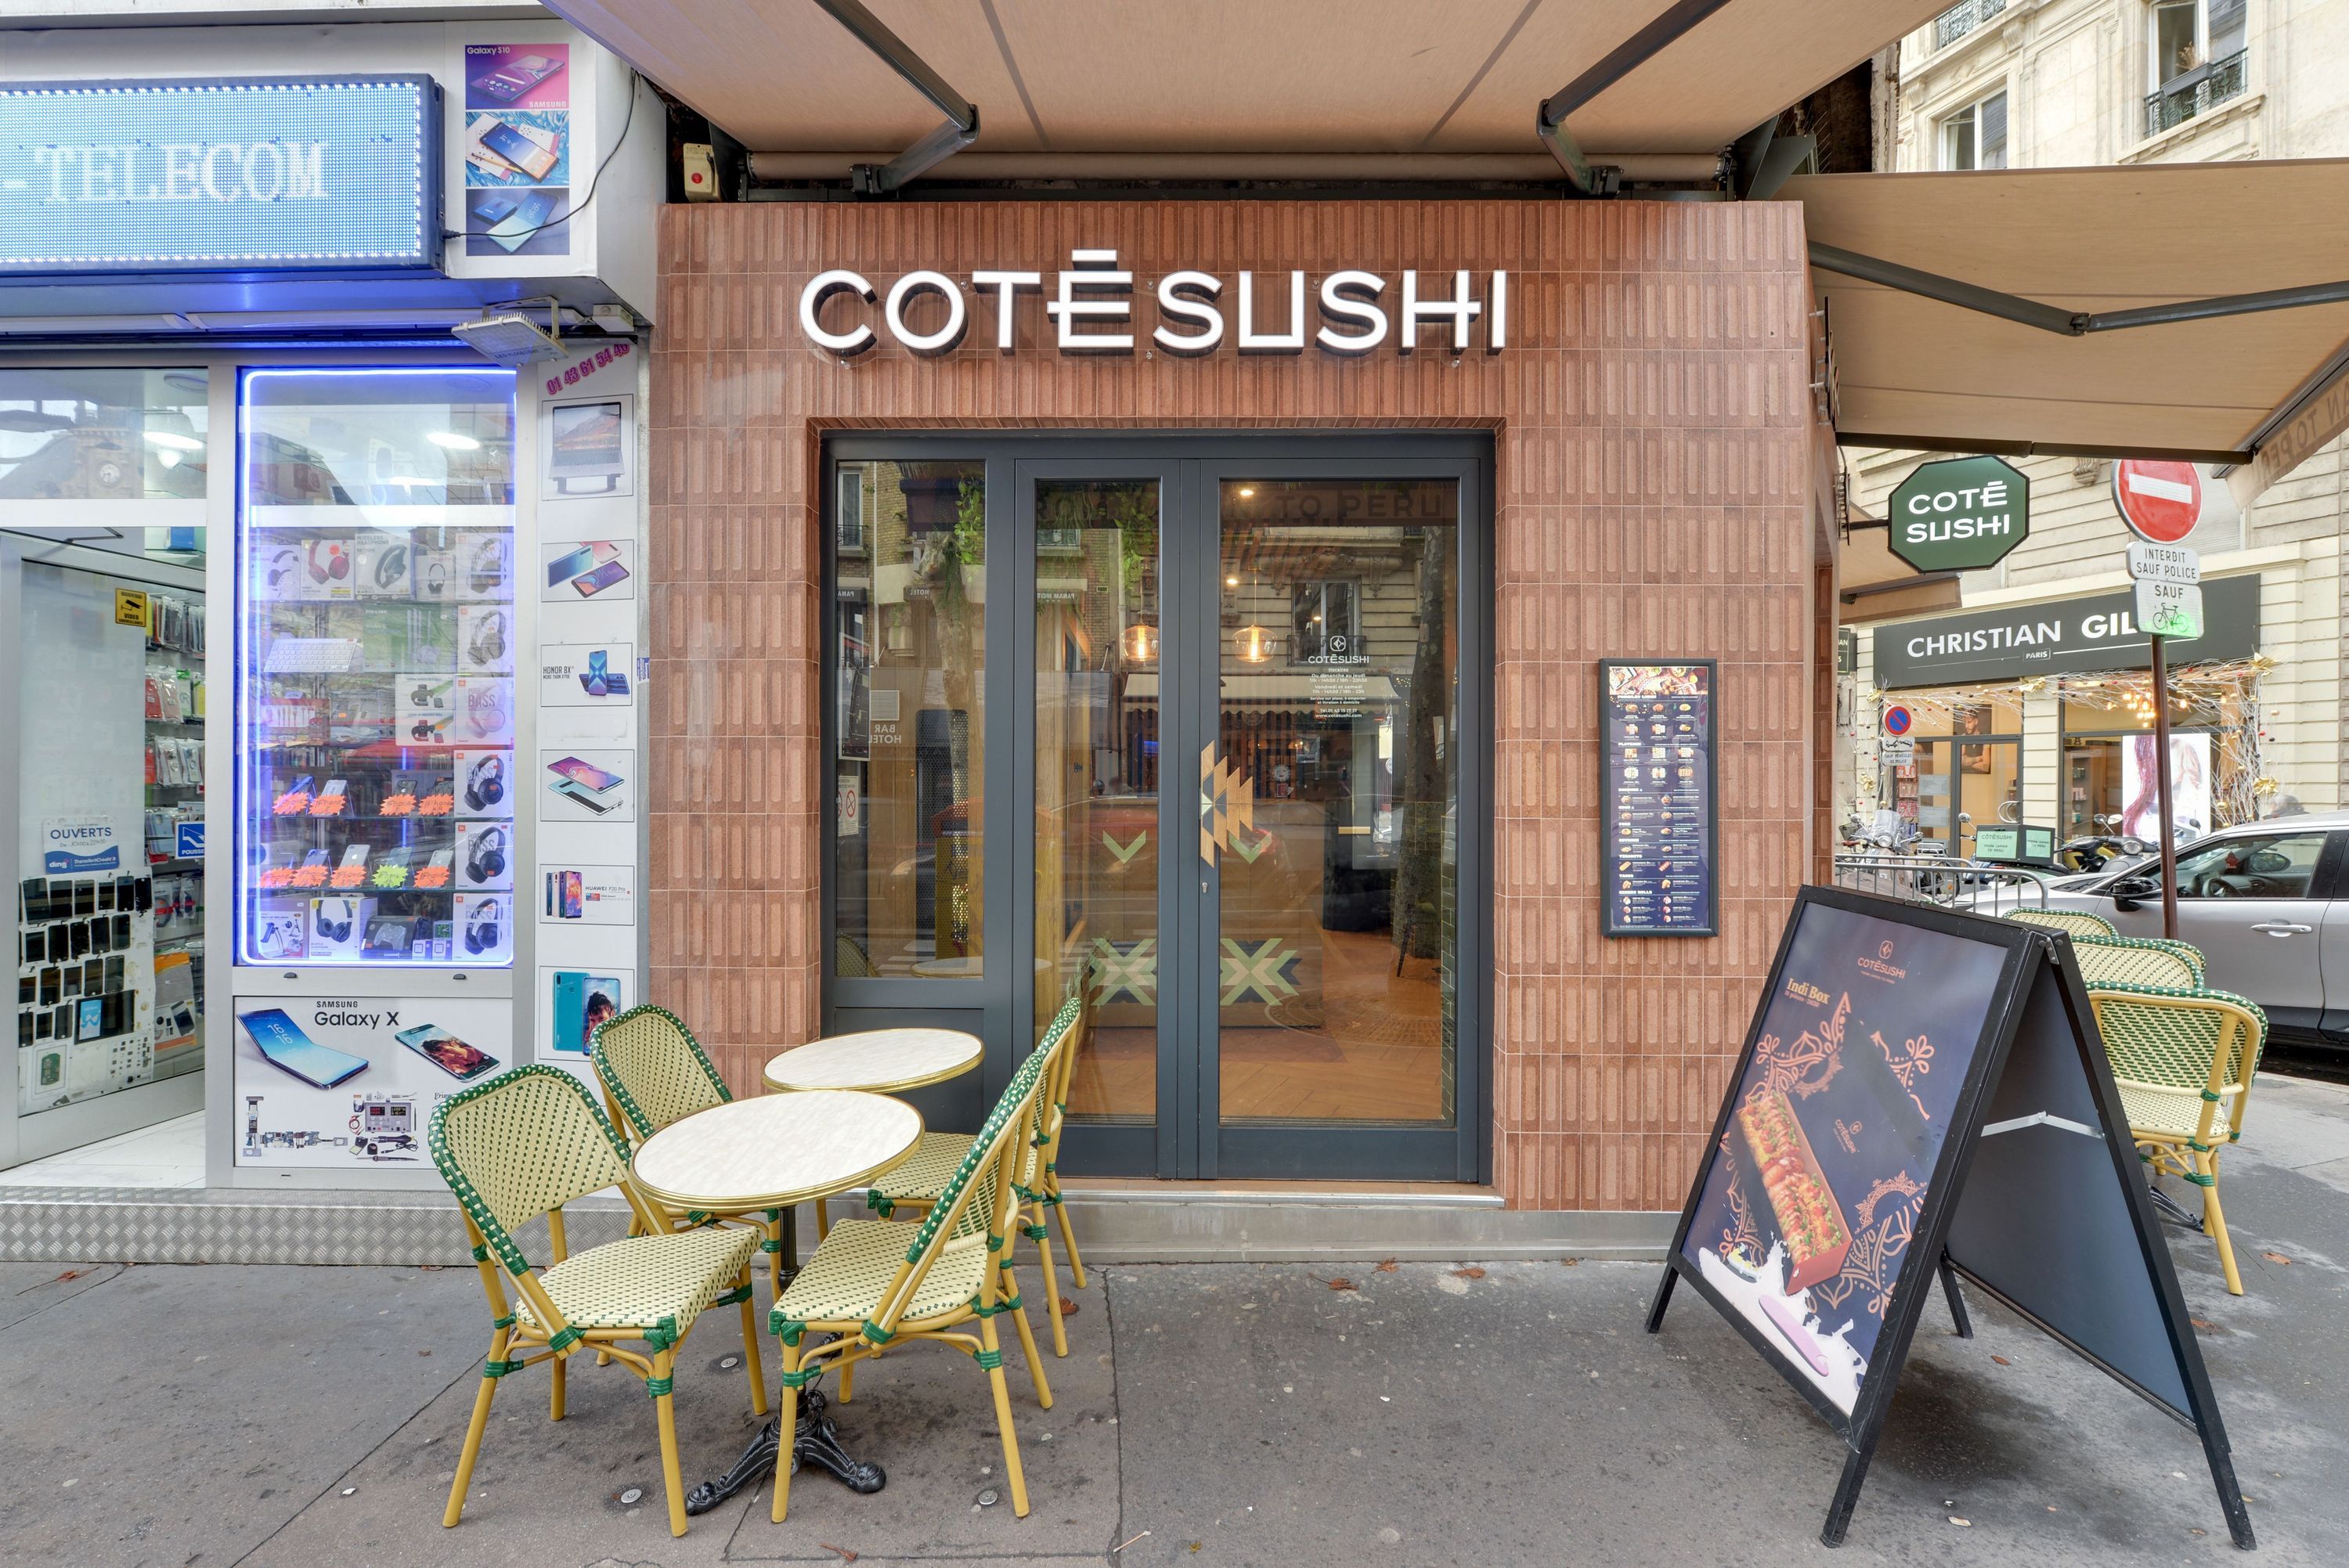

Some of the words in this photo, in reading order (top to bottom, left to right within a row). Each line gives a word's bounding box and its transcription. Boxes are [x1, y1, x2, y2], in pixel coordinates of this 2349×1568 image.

[467, 47, 496, 56] Galaxy
[547, 377, 563, 395] 01
[564, 366, 580, 385] 43
[579, 358, 597, 377] 61
[596, 348, 613, 367] 54
[1906, 514, 2010, 543] SUSHI
[2145, 549, 2185, 563] INTERDIT
[2136, 562, 2160, 575] SAUF
[2164, 565, 2196, 579] POLICE
[2155, 585, 2183, 599] SAUF
[1907, 621, 2061, 658] CHRISTIAN
[2026, 651, 2048, 659] PARIS
[468, 694, 496, 706] BASS
[50, 827, 112, 839] OUVERTS
[468, 839, 495, 852] BASS
[1786, 978, 1810, 996] Indi
[1808, 986, 1831, 1004] Box
[314, 1011, 380, 1029] Galaxy
[386, 1011, 399, 1026] X
[267, 1024, 284, 1033] 16
[276, 1033, 293, 1044] 16
